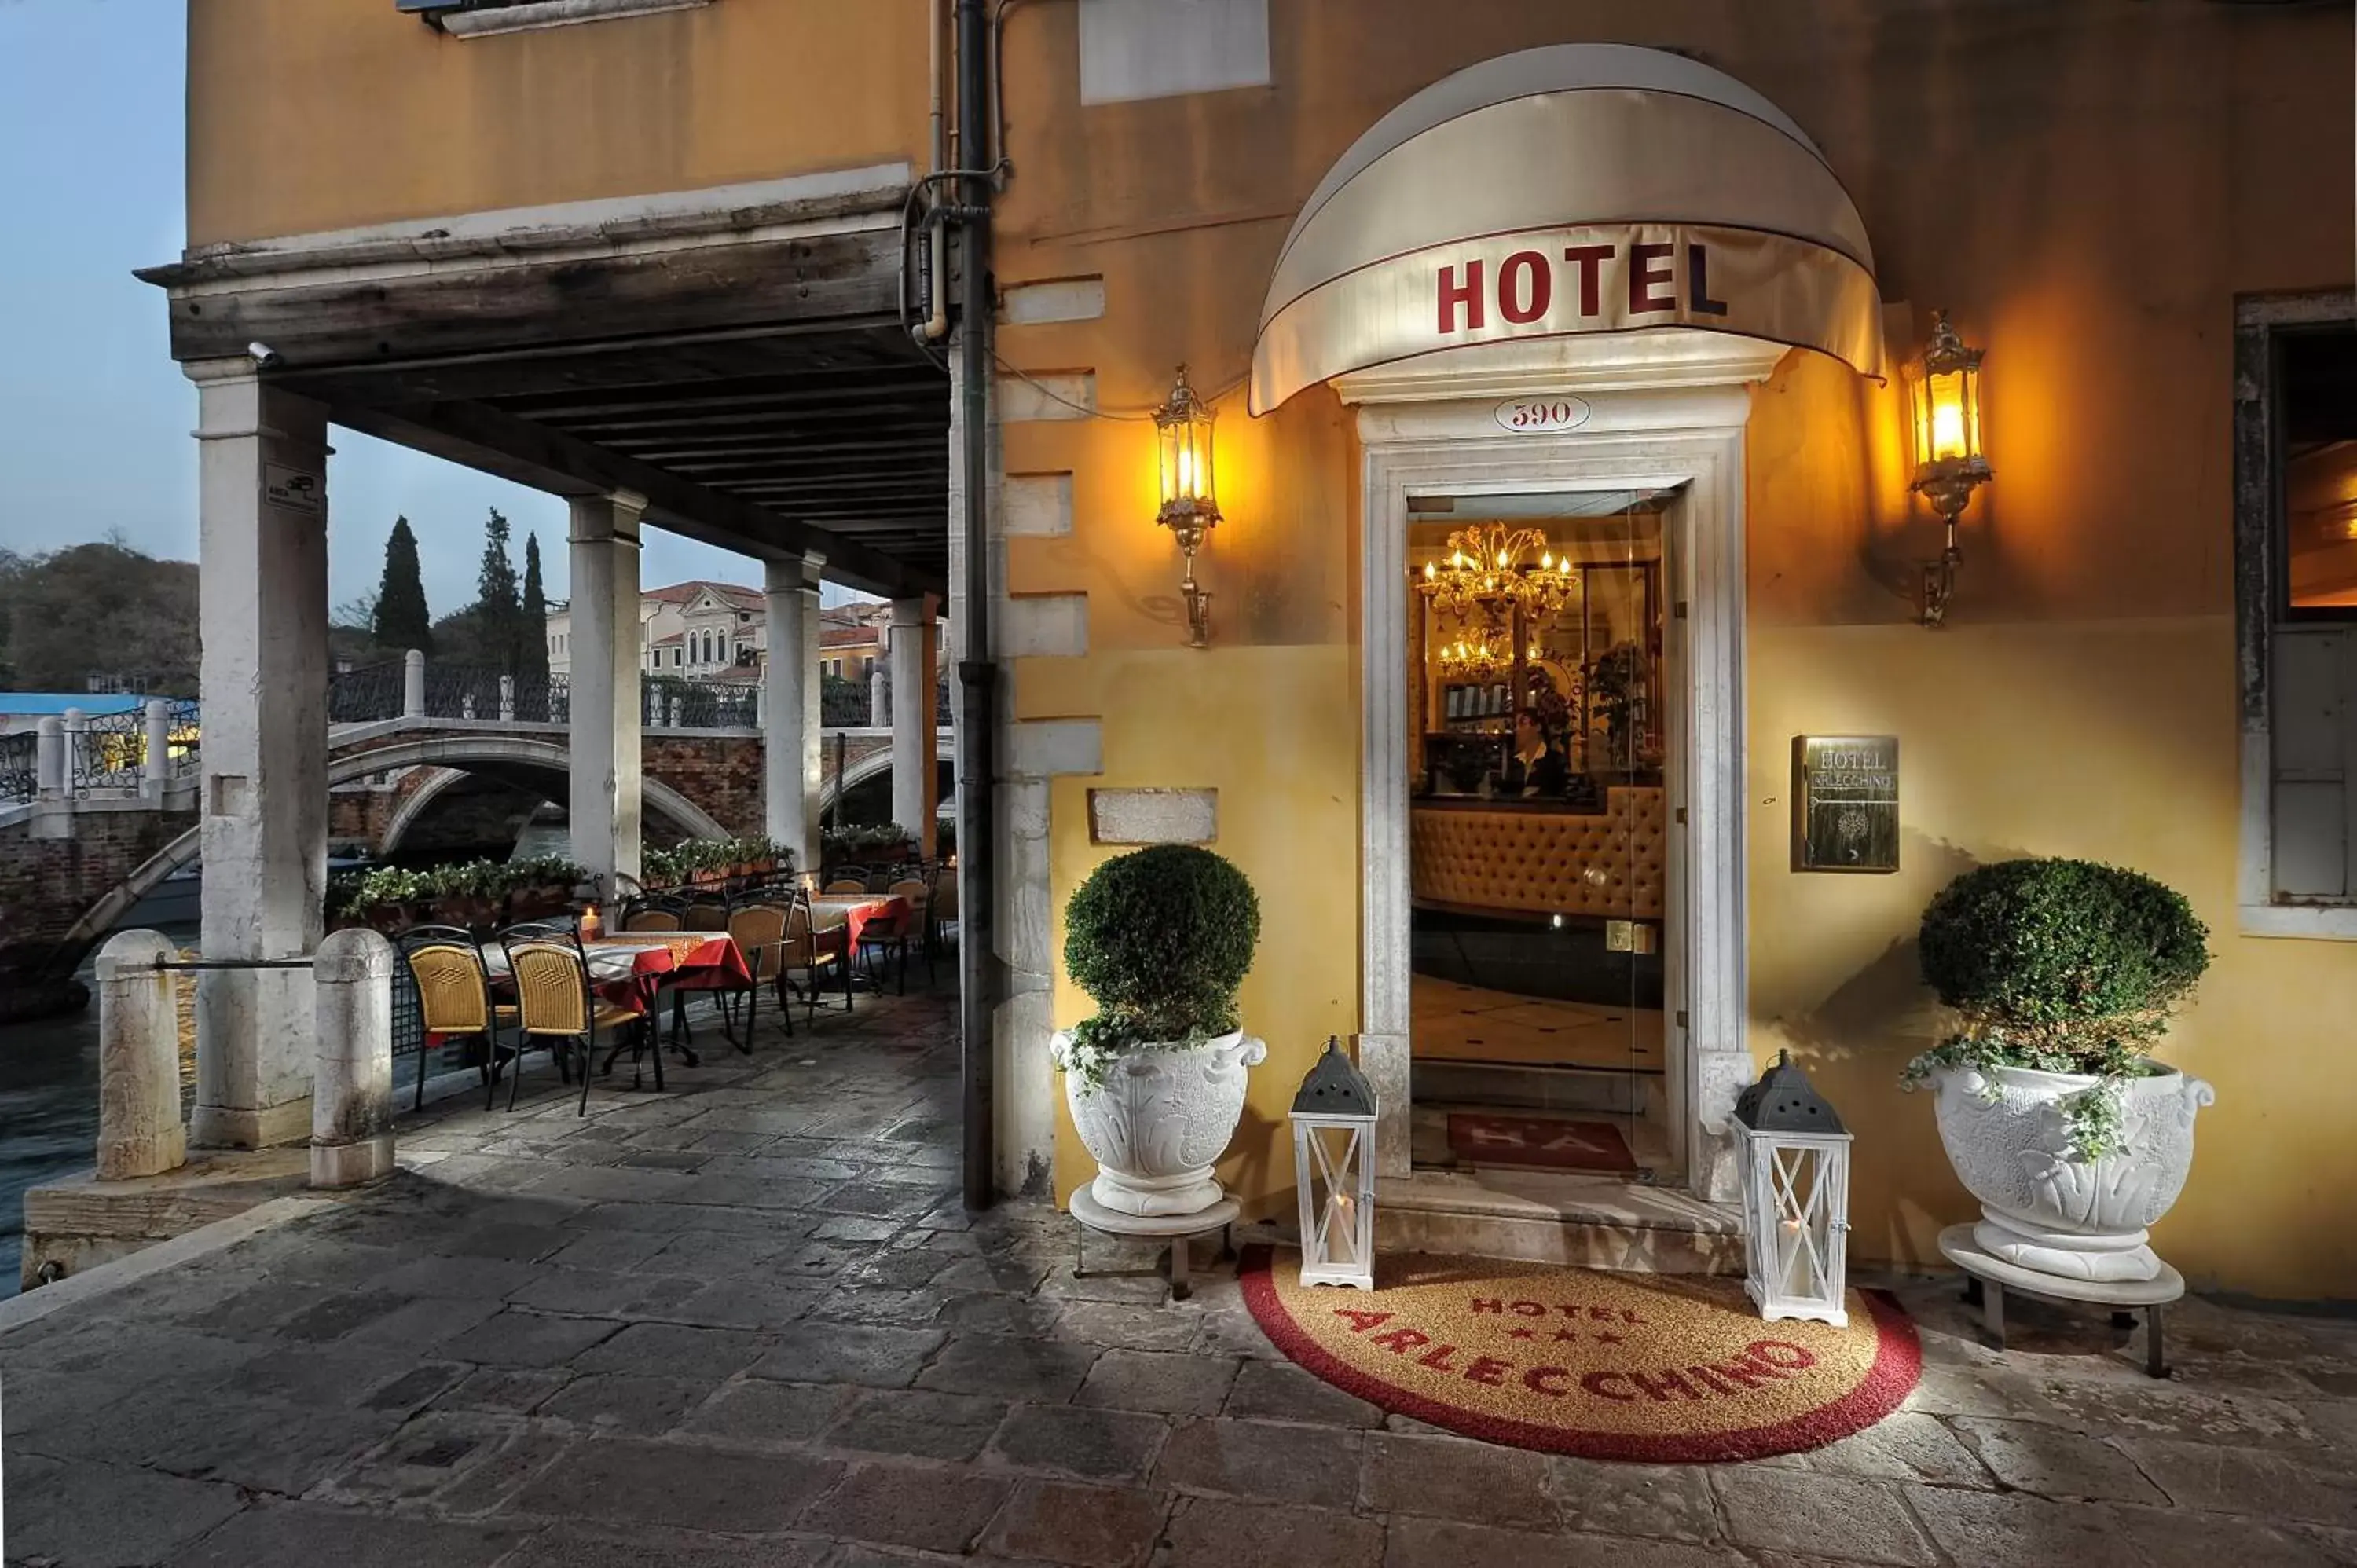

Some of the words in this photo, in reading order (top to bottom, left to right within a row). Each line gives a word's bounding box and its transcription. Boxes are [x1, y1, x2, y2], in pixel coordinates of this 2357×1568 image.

[1438, 244, 1728, 333] HOTEL
[1512, 401, 1571, 427] 590
[1822, 752, 1886, 769] HOTEL
[1472, 1298, 1648, 1324] HOTEL
[1333, 1309, 1816, 1402] ARLECCHINO
